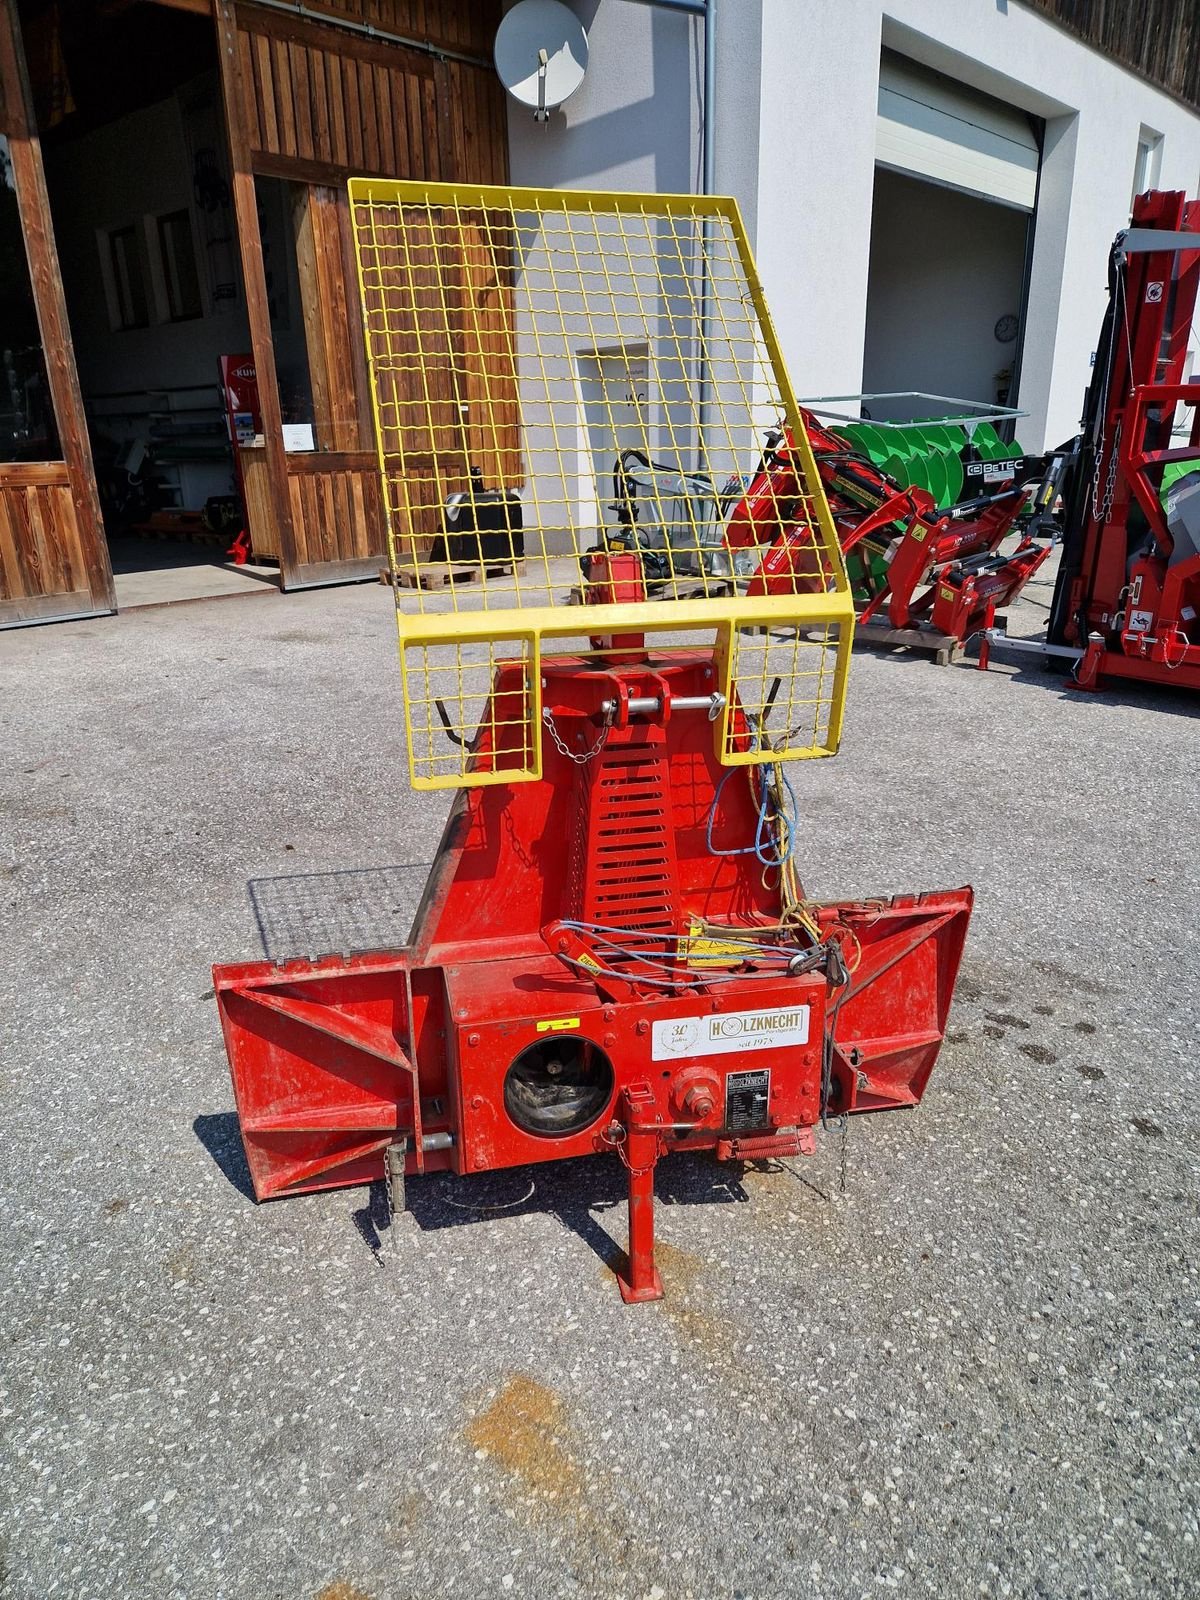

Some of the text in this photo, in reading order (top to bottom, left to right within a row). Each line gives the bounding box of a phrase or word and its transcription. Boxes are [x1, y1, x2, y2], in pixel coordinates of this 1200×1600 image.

[236, 369, 256, 377] KUH
[712, 1012, 801, 1037] HOLZKNECHT
[752, 1037, 774, 1048] 1978
